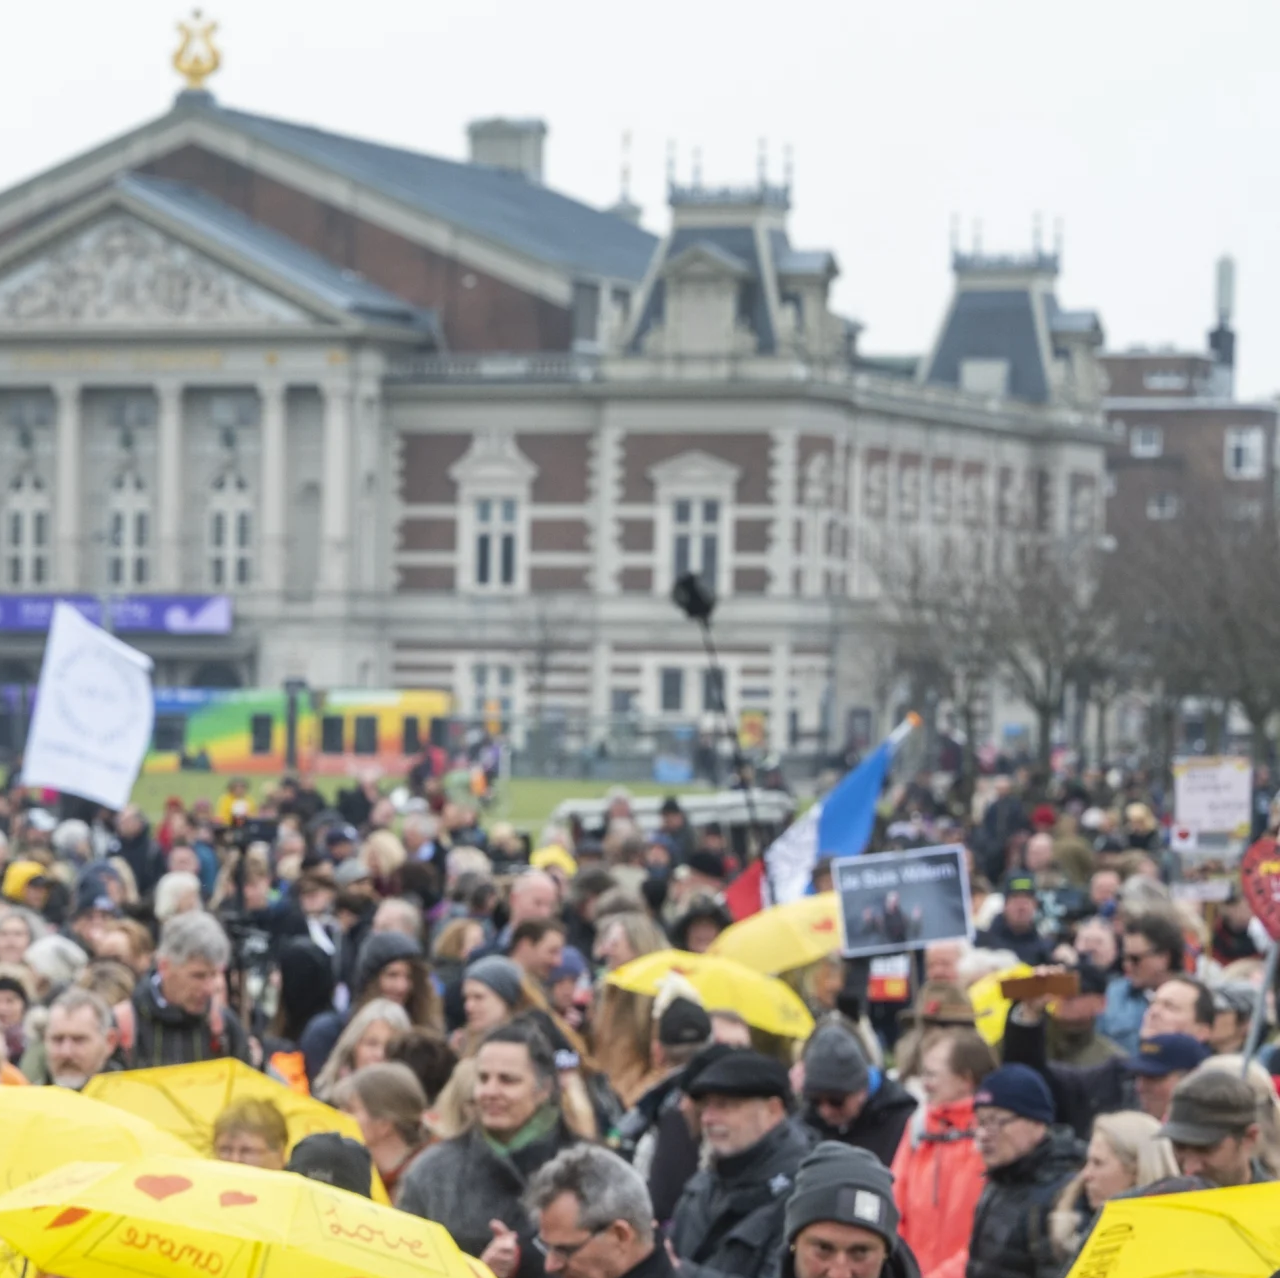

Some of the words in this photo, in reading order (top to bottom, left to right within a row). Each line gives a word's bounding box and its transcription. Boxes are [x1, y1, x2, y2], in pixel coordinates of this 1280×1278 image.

[841, 873, 860, 890] Je
[861, 868, 899, 888] Suis
[900, 861, 957, 884] Willem
